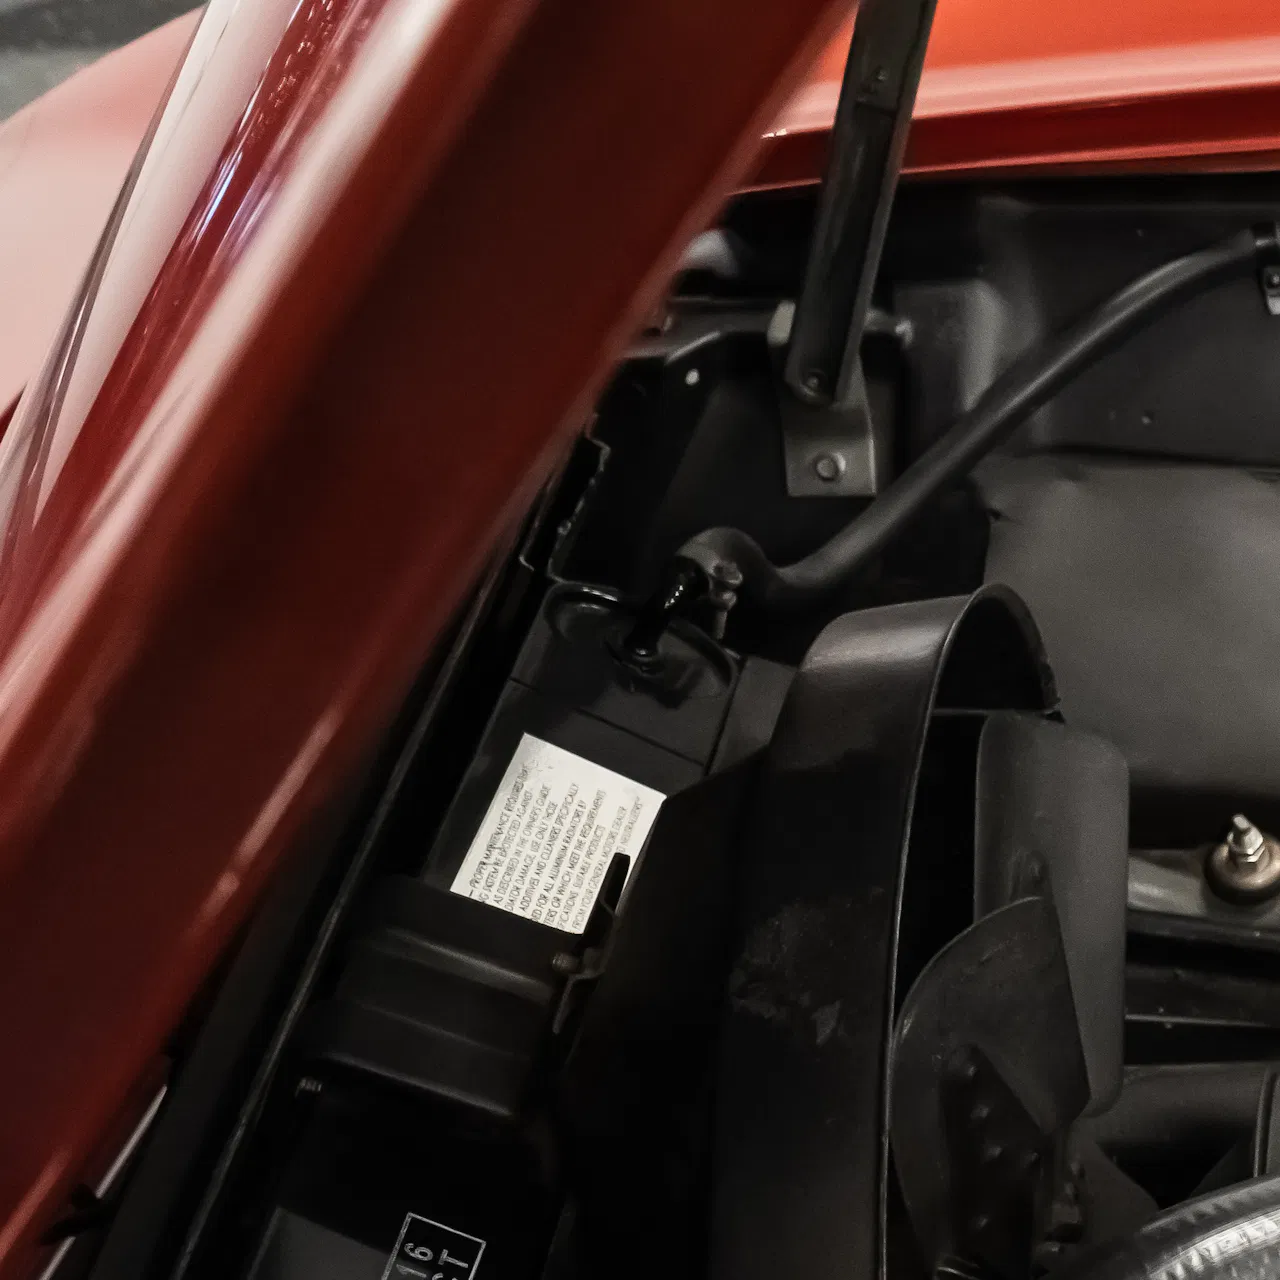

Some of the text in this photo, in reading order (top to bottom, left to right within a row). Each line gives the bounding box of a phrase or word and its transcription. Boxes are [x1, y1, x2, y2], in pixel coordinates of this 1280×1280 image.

[534, 820, 548, 840] ONLY
[562, 808, 583, 844] RADIATORS
[584, 824, 605, 859] PRODUCTS
[469, 860, 488, 888] PROPER
[496, 856, 519, 894] DESCRIBED
[518, 876, 539, 911] ADDITIVES
[539, 826, 561, 861] CLEANERS
[556, 870, 573, 896] WHICH
[566, 851, 579, 869] MEET
[571, 908, 586, 929] FROM
[579, 888, 593, 908] YOUR
[588, 859, 605, 889] GENERAL
[600, 830, 617, 858] MOTORS
[396, 1243, 433, 1278] 16
